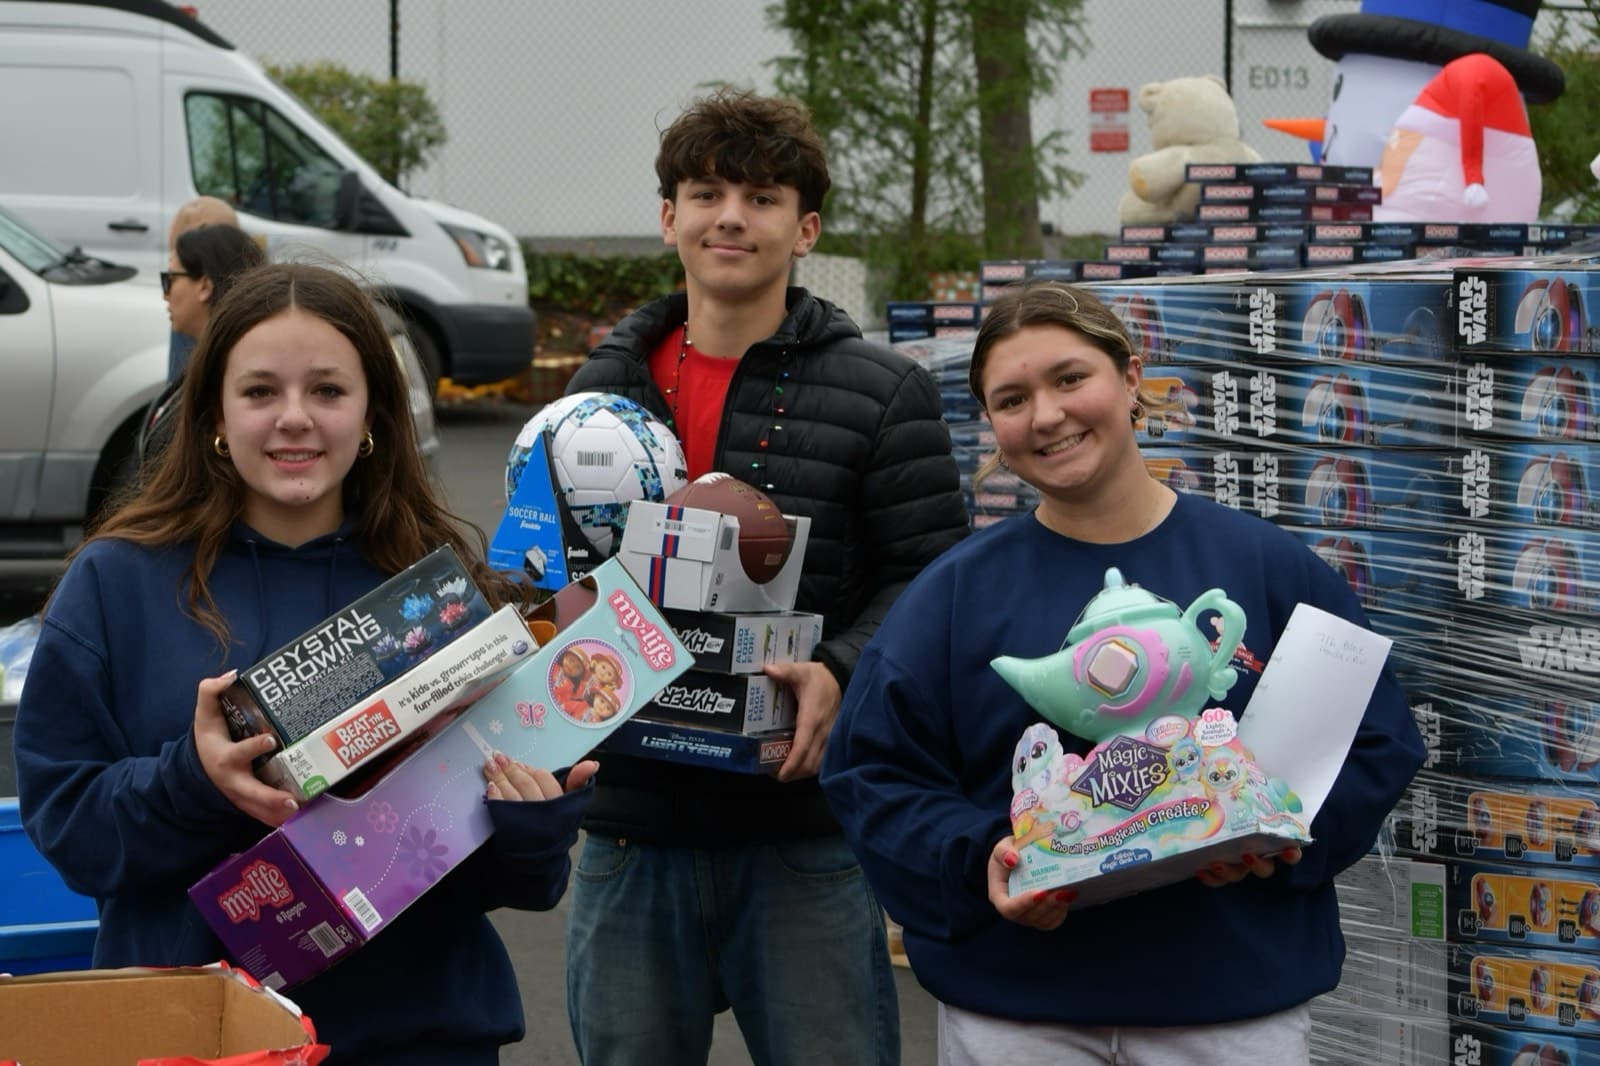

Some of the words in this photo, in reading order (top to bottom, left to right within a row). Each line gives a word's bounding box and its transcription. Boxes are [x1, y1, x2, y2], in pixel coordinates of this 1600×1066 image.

[1250, 288, 1264, 353] STAR
[1263, 288, 1276, 353] WARS
[1459, 276, 1473, 344] STAR
[1472, 276, 1487, 344] WARS
[1212, 371, 1226, 436] WARS
[1225, 371, 1239, 436] STAR
[1250, 372, 1264, 436] STAR
[1263, 372, 1276, 436] WARS
[1466, 363, 1480, 430] STAR
[1479, 363, 1494, 430] WARS
[1213, 452, 1227, 504] WAR
[1253, 453, 1266, 517] STAR
[1266, 453, 1279, 517] WARS
[1462, 450, 1477, 518] STAR
[1475, 450, 1490, 518] WARS
[509, 507, 538, 520] SOCCER
[539, 512, 556, 525] BALL
[1458, 532, 1472, 600] STAR
[1471, 532, 1485, 600] WARS
[250, 609, 372, 688] CRYSTAL
[260, 618, 381, 703] GROWING
[409, 683, 430, 702] kids
[440, 646, 487, 683] grown-ups
[484, 643, 495, 653] in
[494, 634, 508, 647] this
[413, 682, 455, 714] fun-filled
[454, 671, 474, 688] trivia
[473, 650, 508, 676] challenge!
[336, 713, 371, 745] BEAT
[369, 712, 384, 725] THE
[337, 719, 397, 766] PARENTS
[1098, 744, 1148, 772] Magic
[1052, 840, 1069, 853] Who
[1069, 843, 1082, 854] will
[1083, 843, 1099, 854] you
[1100, 821, 1145, 848] Magically
[1147, 801, 1210, 825] Create?
